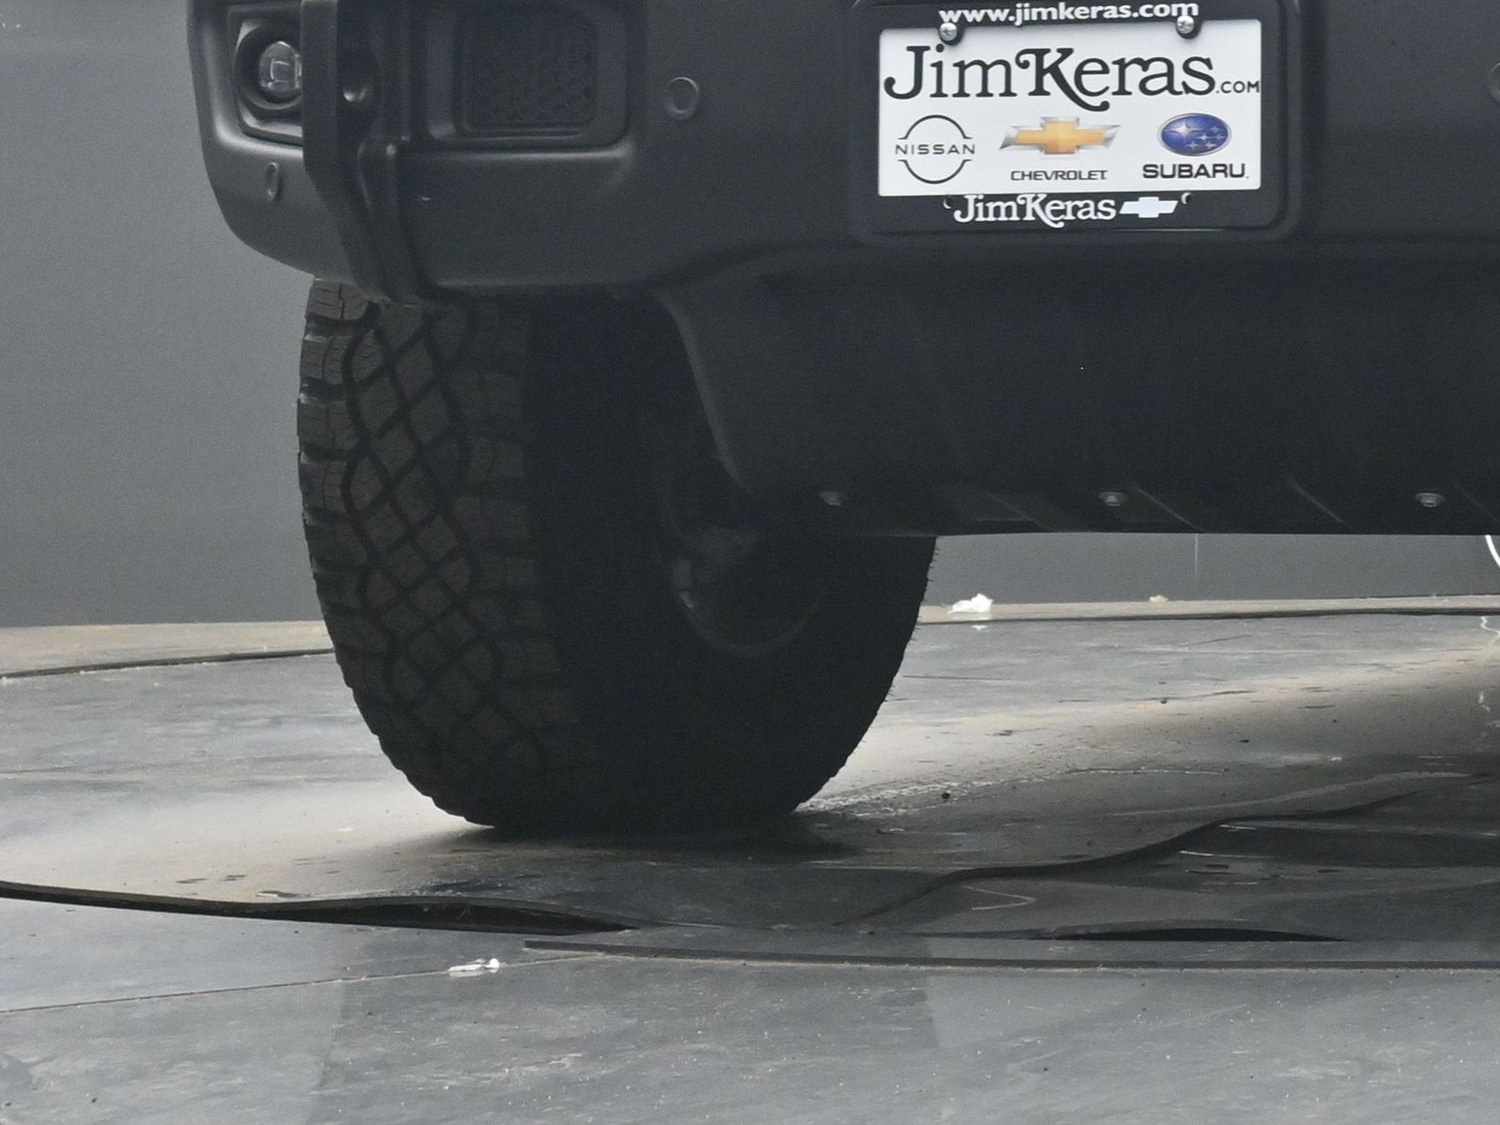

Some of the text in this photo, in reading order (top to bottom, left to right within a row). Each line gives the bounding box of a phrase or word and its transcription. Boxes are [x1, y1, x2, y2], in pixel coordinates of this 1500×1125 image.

[938, 2, 1199, 27] www.jimkeras.com
[895, 143, 975, 155] NISSAN
[1010, 169, 1109, 181] CHEVROLET
[1142, 162, 1247, 179] SUBARU
